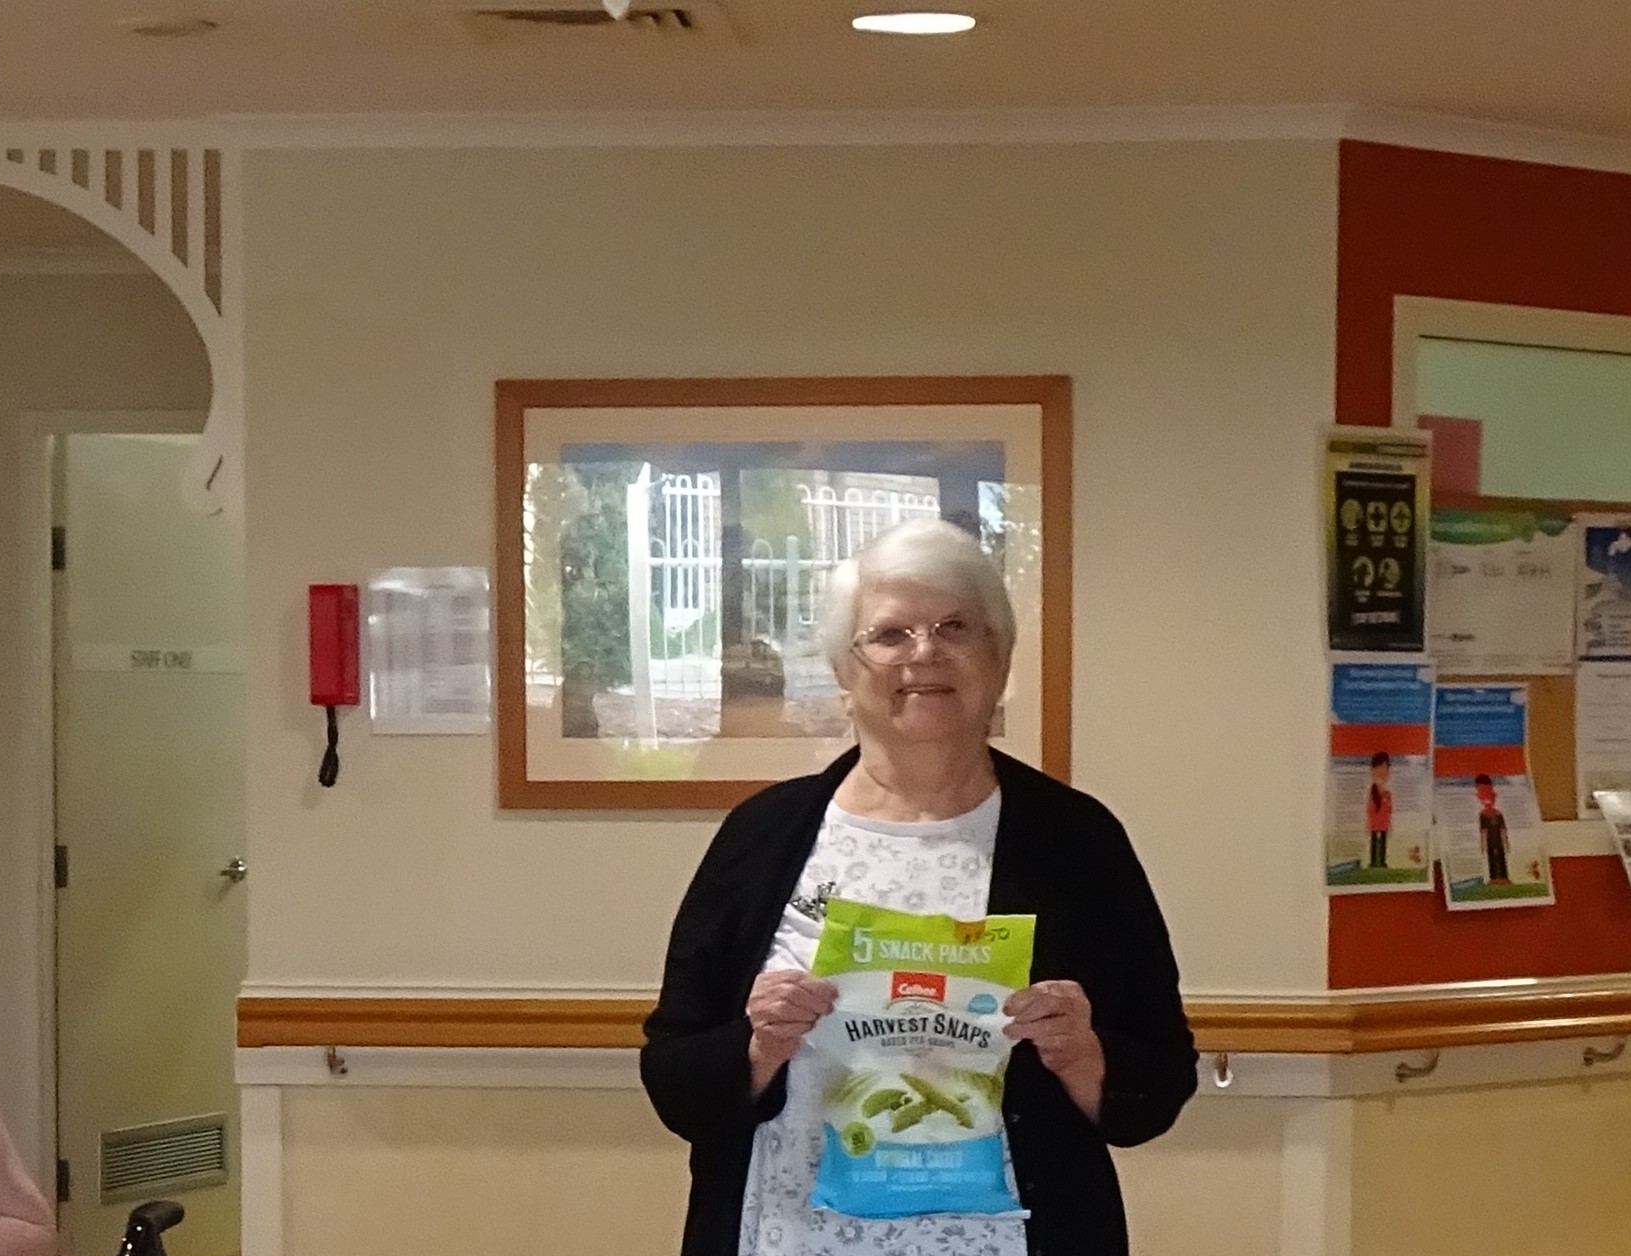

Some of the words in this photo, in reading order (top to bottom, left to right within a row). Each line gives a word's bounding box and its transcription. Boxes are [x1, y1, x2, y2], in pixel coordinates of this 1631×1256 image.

[852, 928, 873, 963] 5
[879, 939, 934, 963] SNACK
[939, 943, 992, 965] PACKS
[844, 1016, 929, 1042] HARVEST
[934, 1013, 992, 1049] SNAPS
